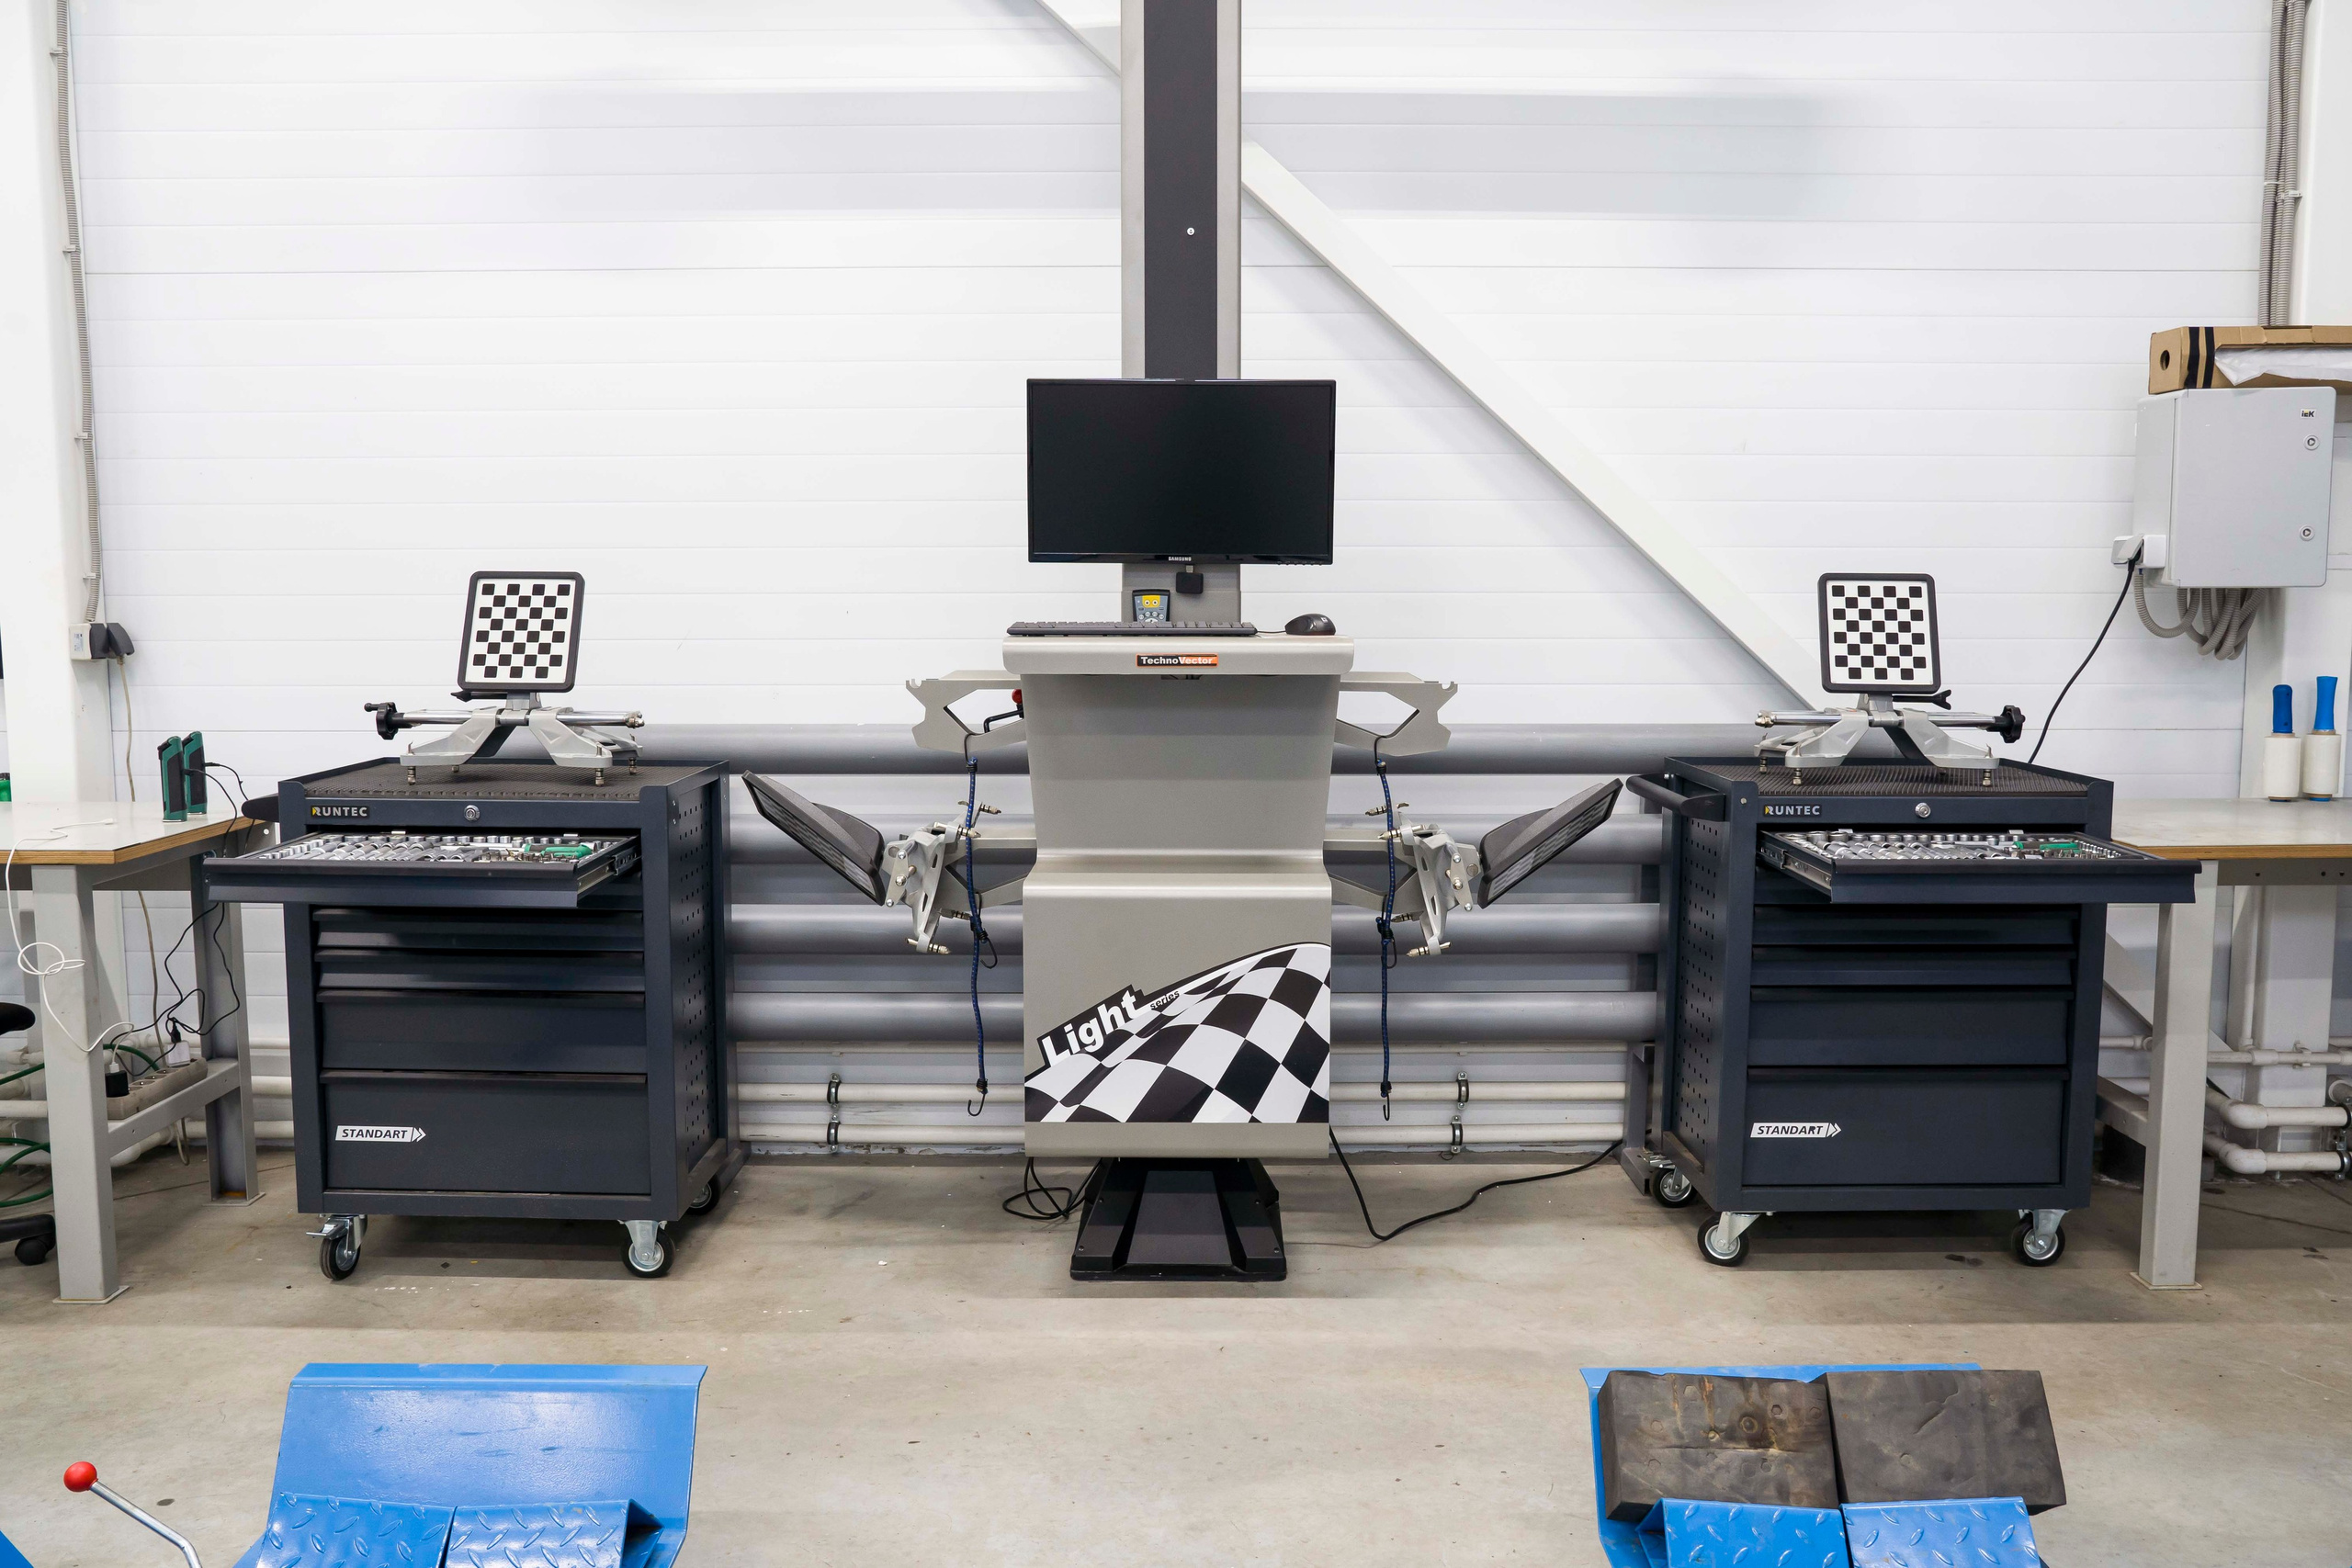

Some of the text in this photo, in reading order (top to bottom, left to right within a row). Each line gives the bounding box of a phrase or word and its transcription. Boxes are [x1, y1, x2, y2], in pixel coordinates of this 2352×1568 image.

[1140, 656, 1213, 665] TechnoVector
[312, 807, 368, 817] RUNTEC
[1765, 806, 1820, 816] RUNTEC
[1041, 989, 1180, 1067] Light series
[342, 1128, 408, 1139] STANDART
[1757, 1125, 1824, 1135] STANDART
